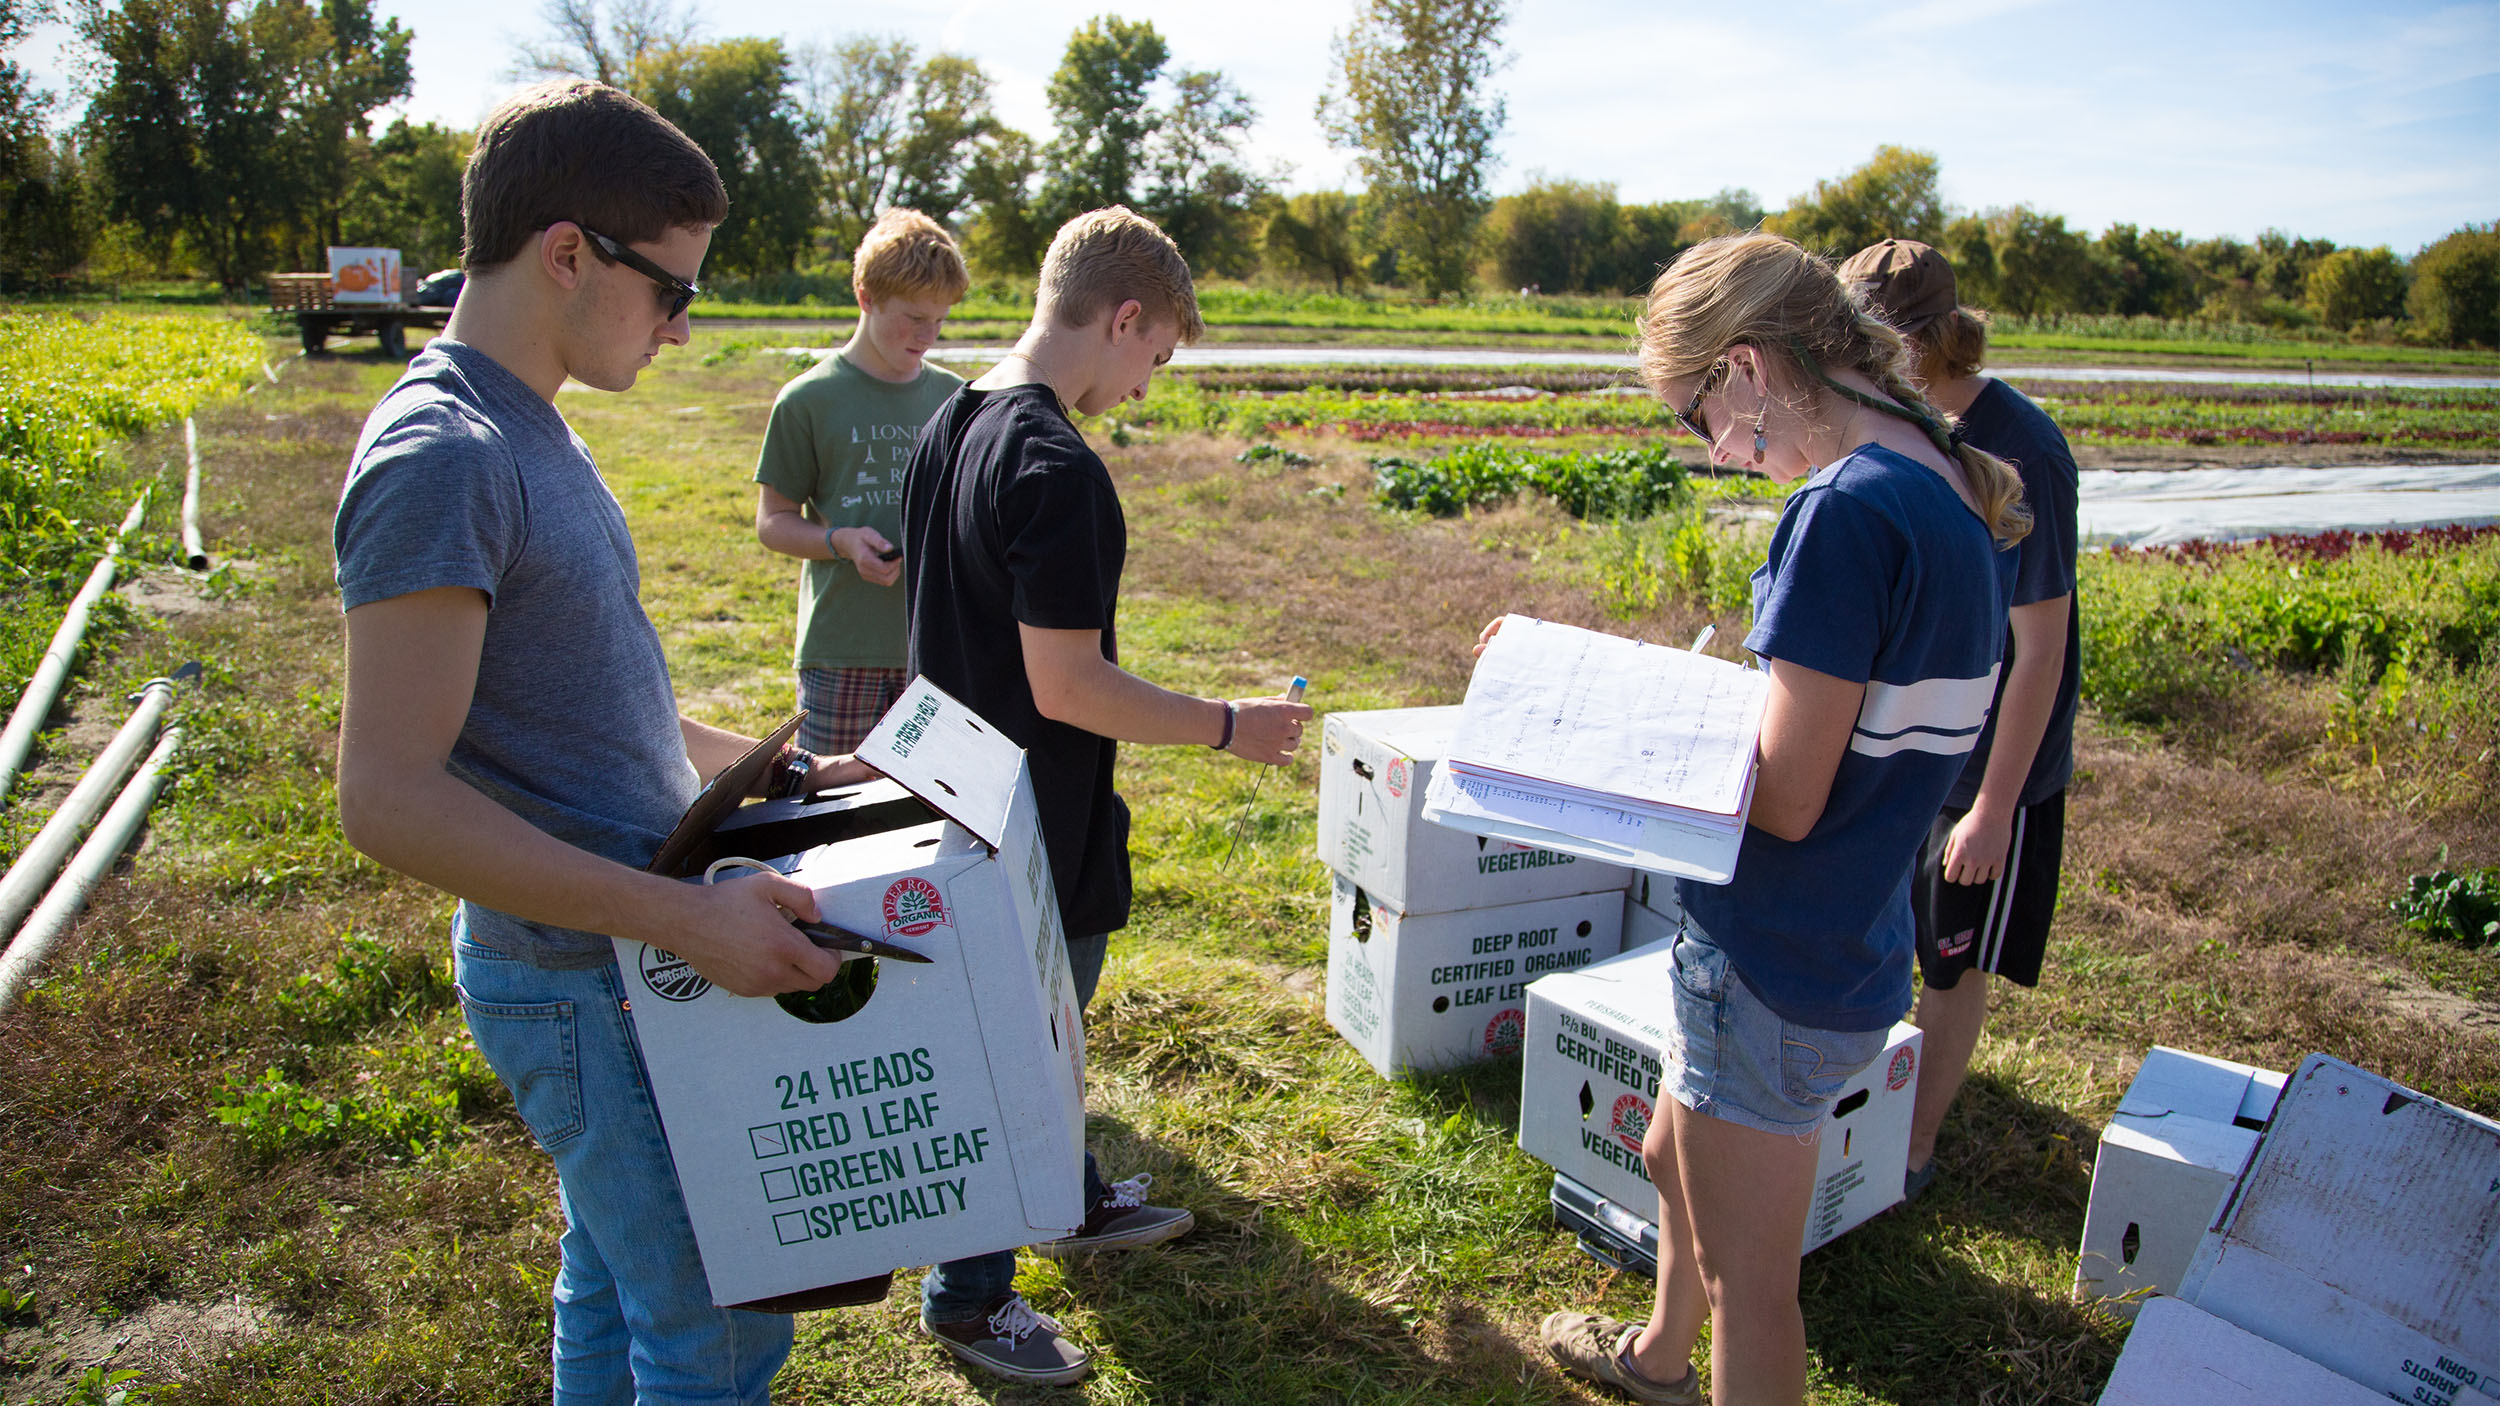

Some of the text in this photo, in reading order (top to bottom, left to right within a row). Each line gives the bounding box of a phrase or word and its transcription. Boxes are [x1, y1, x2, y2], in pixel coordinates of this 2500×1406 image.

[916, 693, 942, 720] HEALTH
[891, 740, 911, 758] EAT
[895, 719, 925, 748] FRESH
[1477, 849, 1577, 875] VEGETABLES
[885, 883, 903, 916] DEEP
[907, 879, 942, 909] ROOT
[893, 911, 943, 928] ORGANIC
[1472, 927, 1559, 955] DEEP ROOT
[654, 965, 698, 985] ORGAN
[1431, 948, 1592, 985] CERTIFIED ORGANIC
[1455, 986, 1494, 1008] LEAF
[1581, 1022, 1601, 1044] BU.
[1605, 1037, 1637, 1064] DEEP
[775, 1047, 935, 1111] 24 HEADS
[1556, 1033, 1642, 1091] CERTIFIED
[786, 1091, 940, 1154] RED LEAF
[799, 1127, 990, 1197] GREEN LEAF
[1581, 1127, 1652, 1183] VEGETA
[810, 1176, 967, 1239] SPECIALTY
[2400, 1359, 2459, 1396] ARROTS
[2435, 1355, 2478, 1385] CORN
